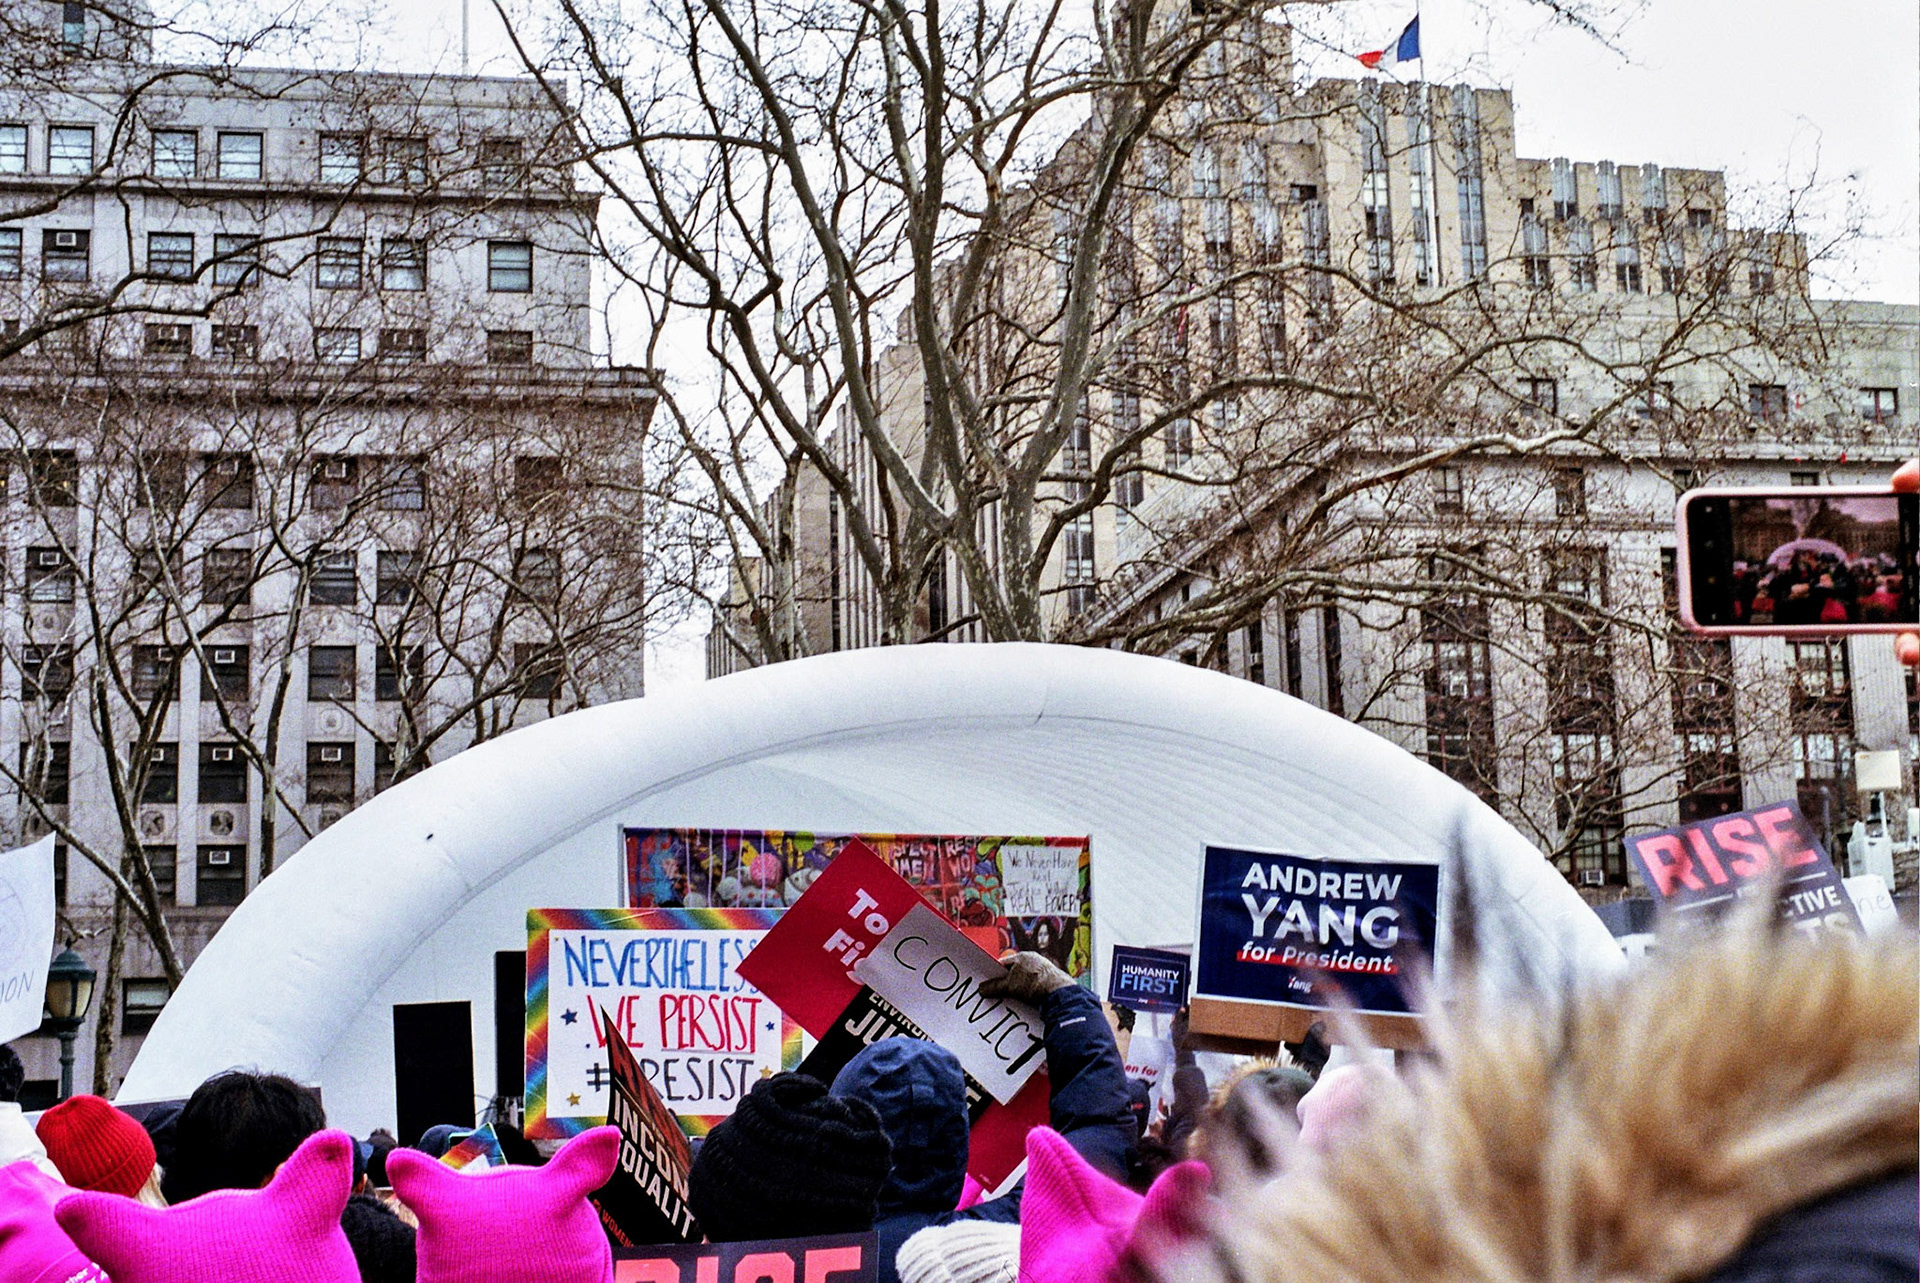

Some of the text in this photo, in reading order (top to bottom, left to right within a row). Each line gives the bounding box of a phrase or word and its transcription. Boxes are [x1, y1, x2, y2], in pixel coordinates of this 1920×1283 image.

[1636, 806, 1819, 897] RISE
[1241, 862, 1403, 901] ANDREW
[1241, 893, 1400, 949] YANG
[1122, 964, 1180, 980] HUMANITY
[1242, 941, 1393, 973] for President
[1120, 973, 1179, 995] FIRST
[586, 994, 762, 1054] WE PERSIST
[894, 936, 1046, 1075] CONVICT
[1141, 1065, 1158, 1076] for
